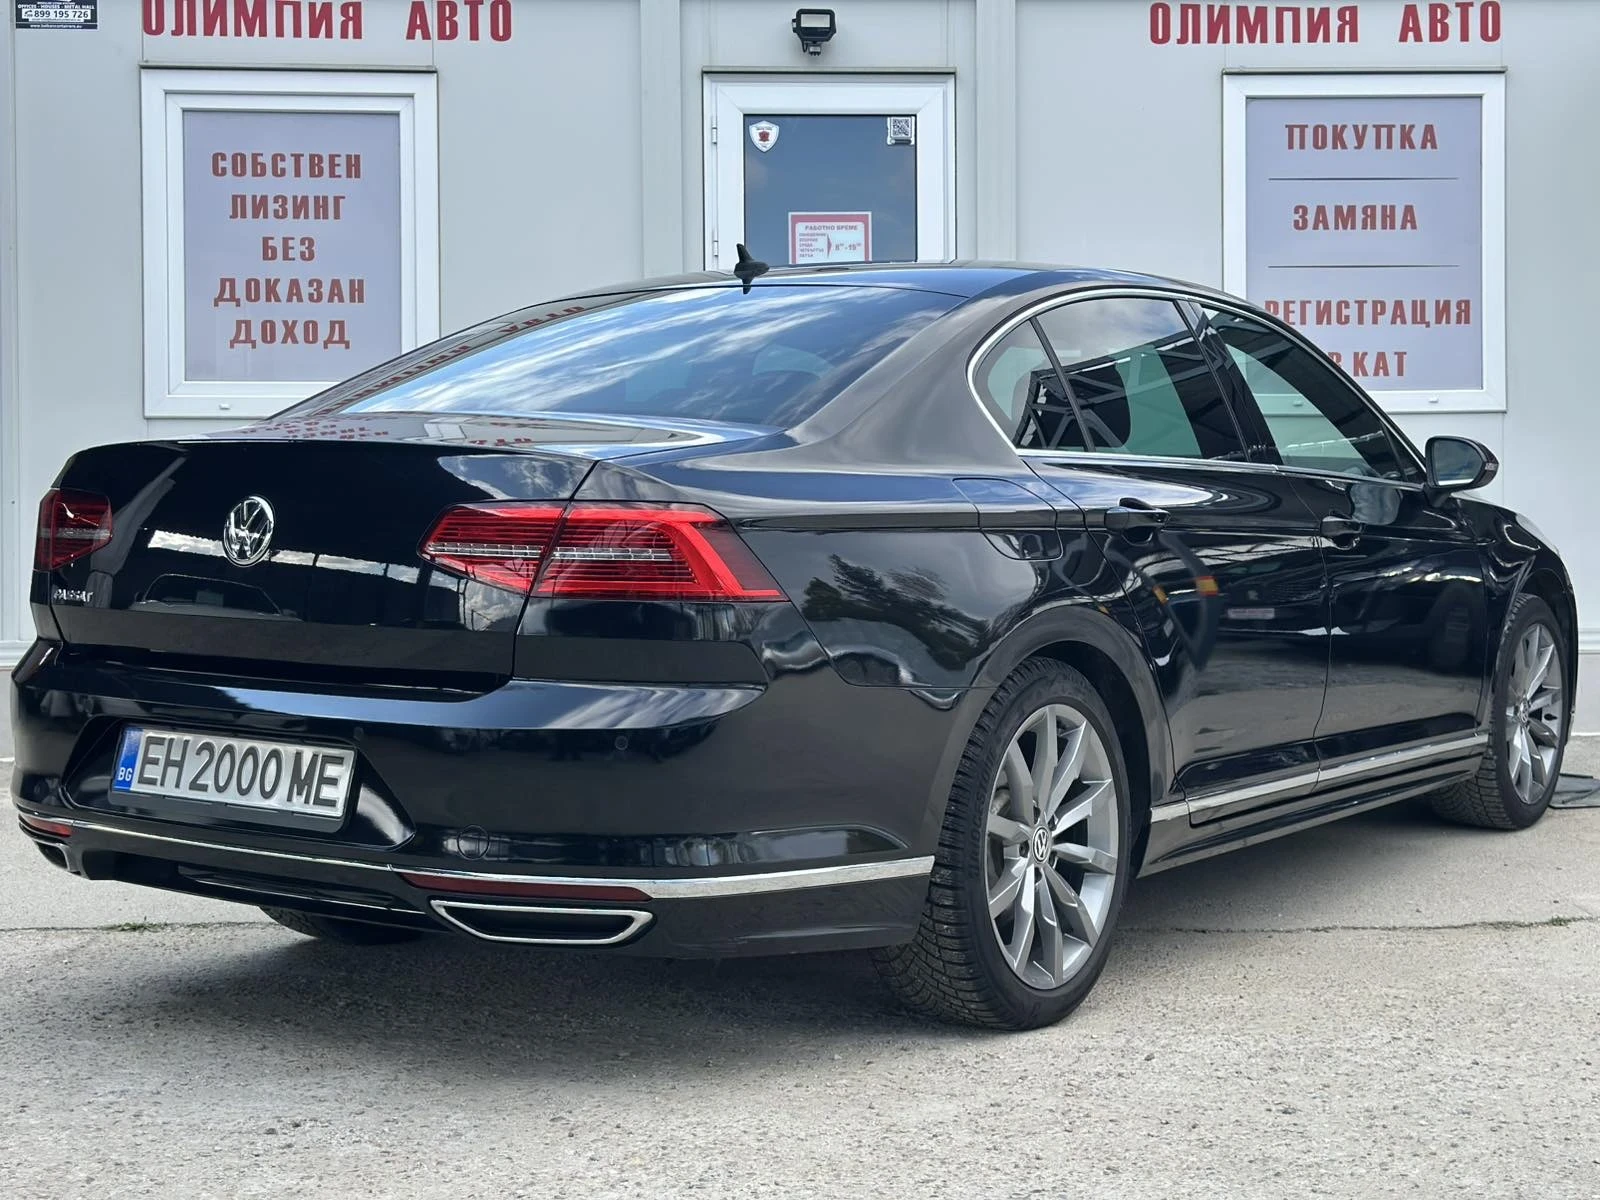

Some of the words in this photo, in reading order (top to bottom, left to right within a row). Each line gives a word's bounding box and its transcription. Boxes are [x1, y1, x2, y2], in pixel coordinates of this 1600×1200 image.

[34, 10, 51, 18] 899
[54, 10, 70, 18] 195
[73, 10, 89, 18] 726
[142, 0, 363, 40] ОЛИМПИЯ
[406, 0, 513, 42] АВТО
[1150, 2, 1359, 46] ОЛИМПИЯ
[1399, 1, 1502, 44] АВТО
[1285, 123, 1438, 150] ПОКУПКА
[211, 151, 363, 179] СОБСТВЕН
[229, 194, 346, 220] ЛИЗИНГ
[1293, 204, 1418, 231] ЗАМЯНА
[261, 236, 316, 262] БЕЗ
[213, 277, 366, 307] ДОКАЗАН
[229, 319, 351, 349] ДОХОД
[1353, 351, 1407, 377] КАТ
[117, 767, 134, 782] BG
